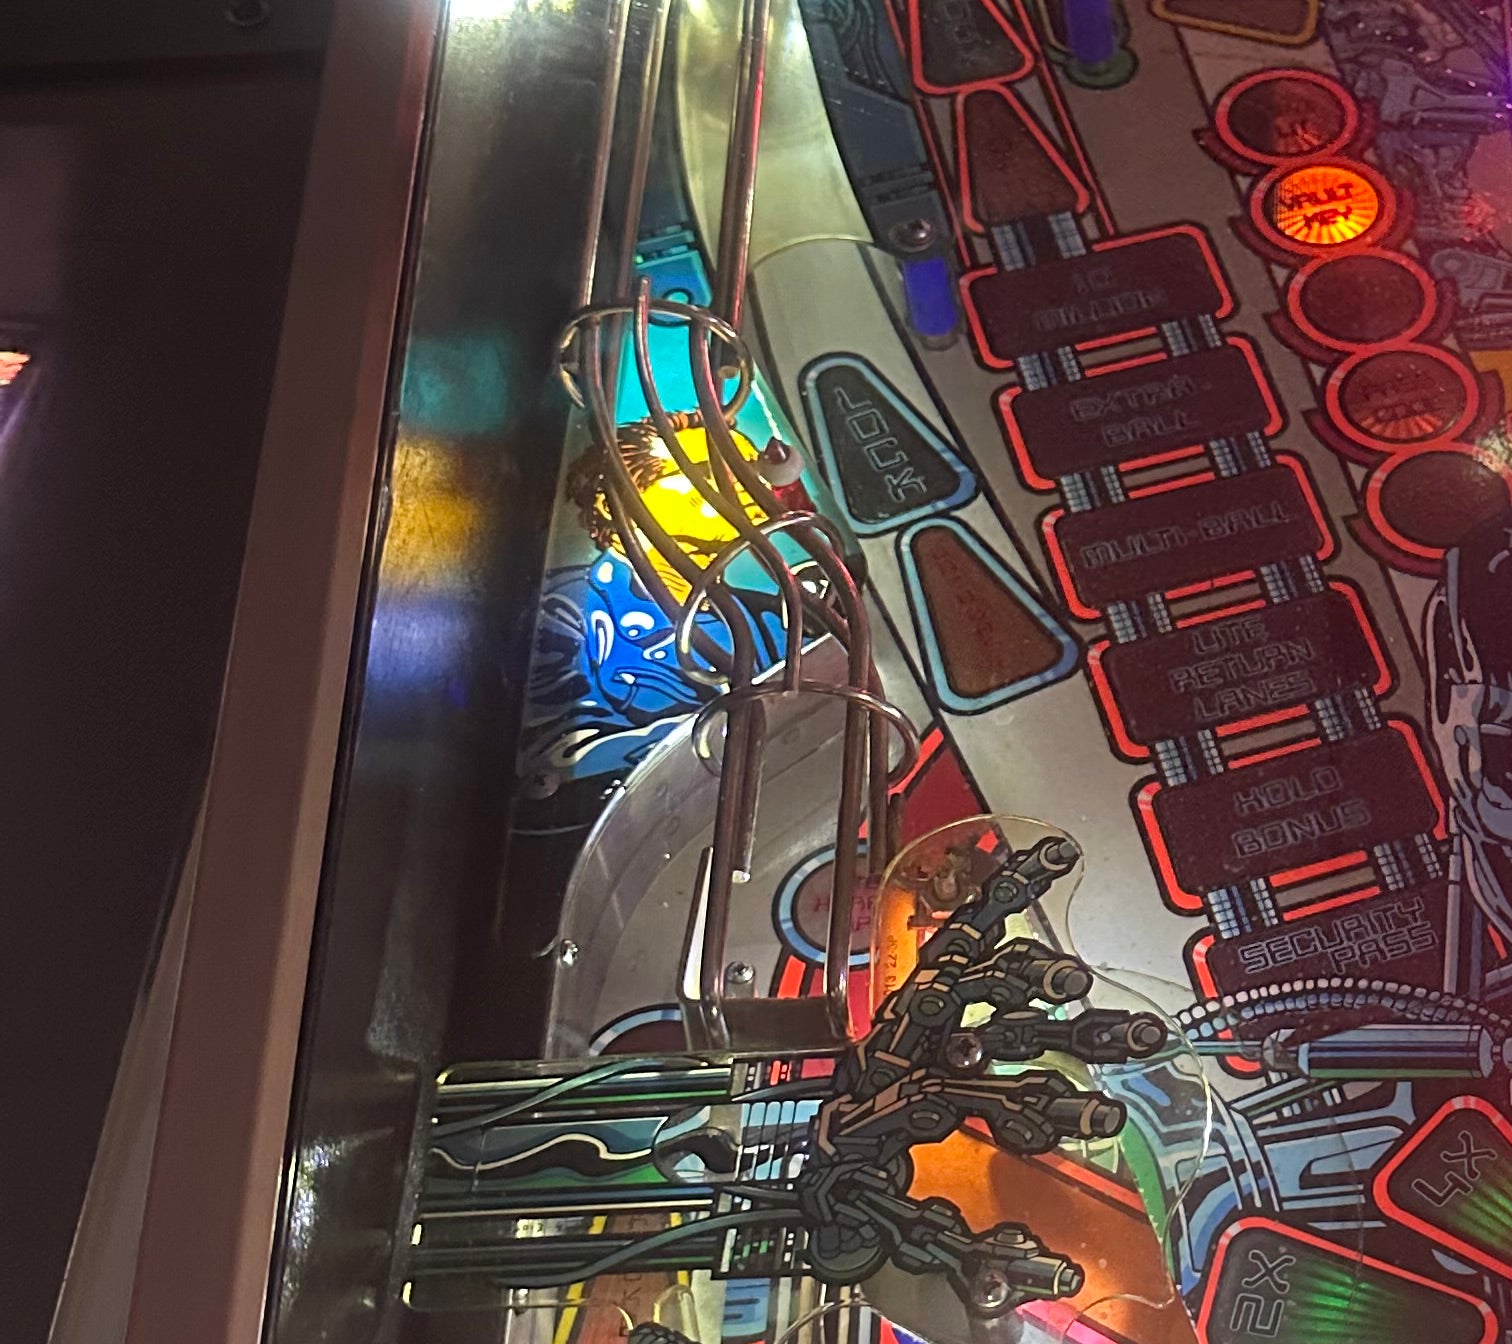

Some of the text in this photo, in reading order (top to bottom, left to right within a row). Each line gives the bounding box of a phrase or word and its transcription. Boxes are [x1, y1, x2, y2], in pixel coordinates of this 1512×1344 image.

[1191, 613, 1271, 656] LITE
[1166, 637, 1316, 696] RETURN
[1192, 668, 1318, 723] LANES
[1232, 764, 1345, 818] HOLD
[1230, 798, 1372, 859] BONUS
[1238, 897, 1425, 975] SECURITY
[1329, 920, 1438, 974] PASS
